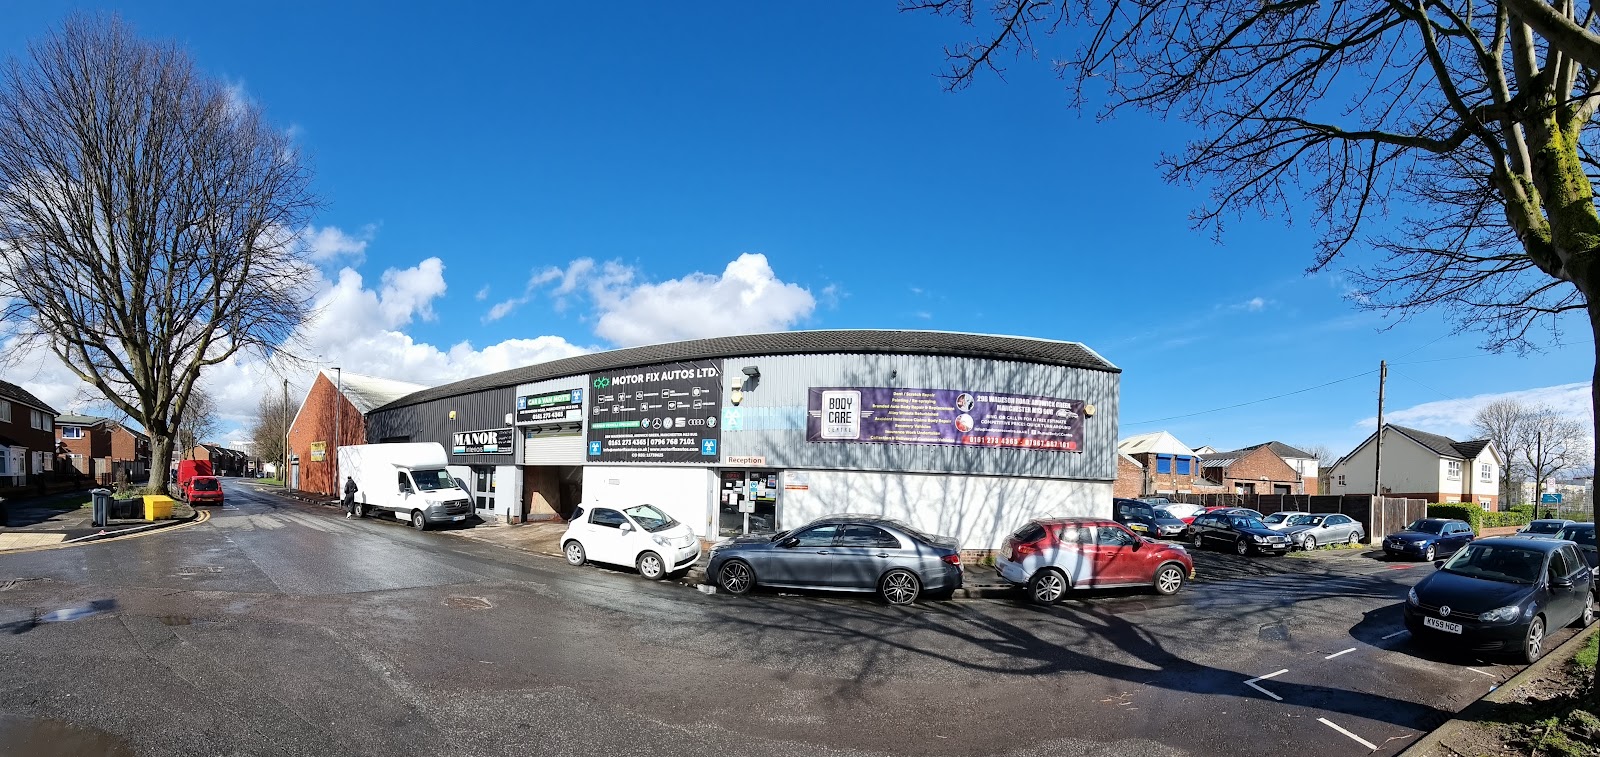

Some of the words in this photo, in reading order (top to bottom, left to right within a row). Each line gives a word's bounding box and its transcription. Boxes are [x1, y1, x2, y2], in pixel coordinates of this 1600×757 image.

[612, 374, 644, 386] MOTOR
[646, 372, 660, 382] FIX
[661, 369, 694, 380] AUTOS
[697, 367, 719, 378] LTD.
[829, 398, 852, 409] BODY
[996, 404, 1031, 413] MANCHESTER
[829, 412, 852, 423] CARE
[454, 432, 498, 446] MANOR
[728, 457, 762, 465] Reception
[1427, 617, 1444, 629] KV59
[1445, 622, 1459, 632] HGC
